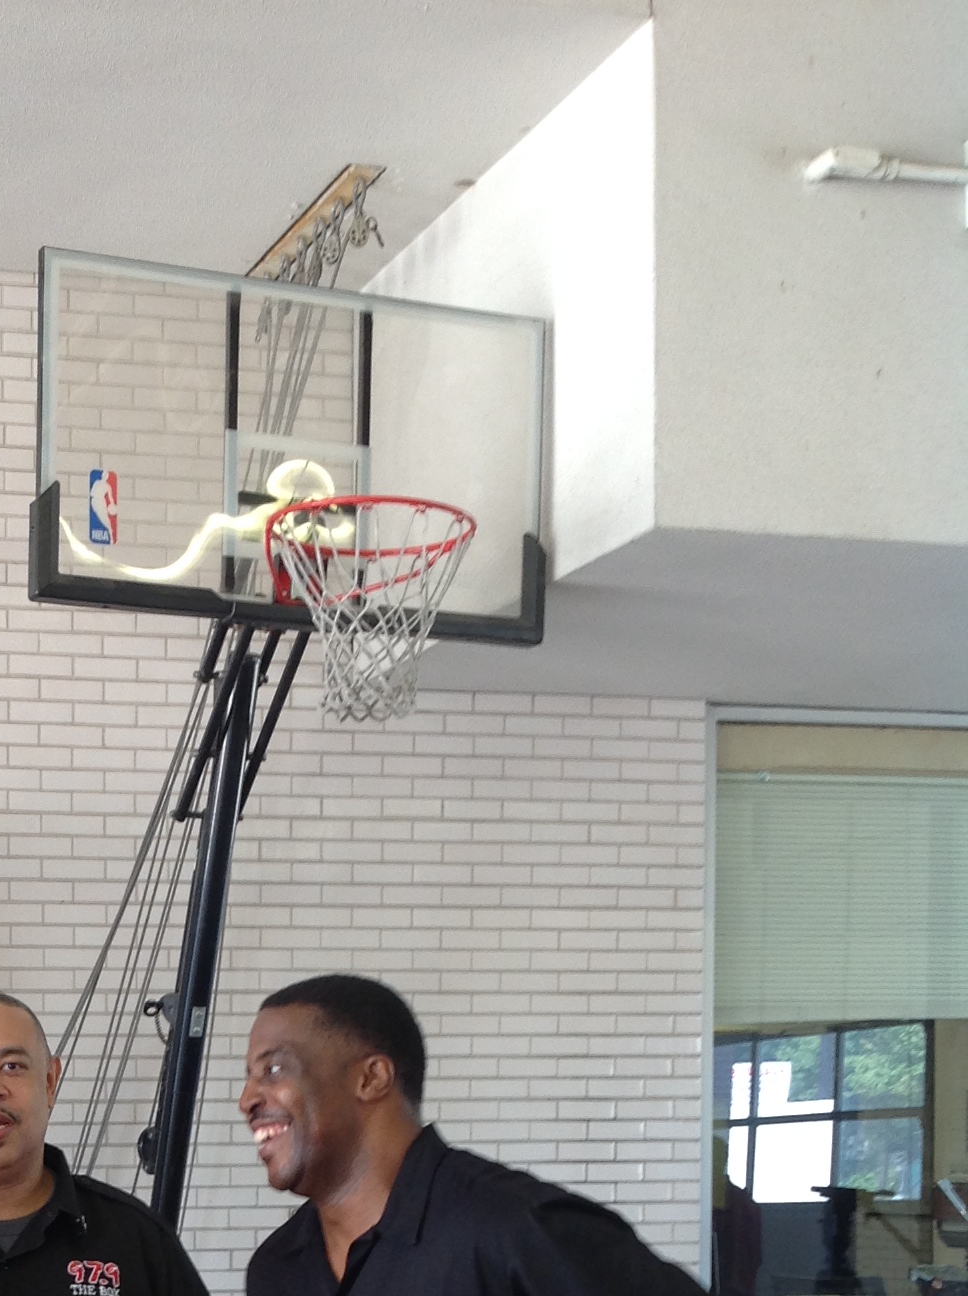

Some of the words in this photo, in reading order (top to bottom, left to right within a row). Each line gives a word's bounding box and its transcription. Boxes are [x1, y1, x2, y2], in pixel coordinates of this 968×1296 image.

[92, 529, 109, 540] NBA
[67, 1260, 120, 1288] 97.9
[69, 1284, 97, 1296] THE
